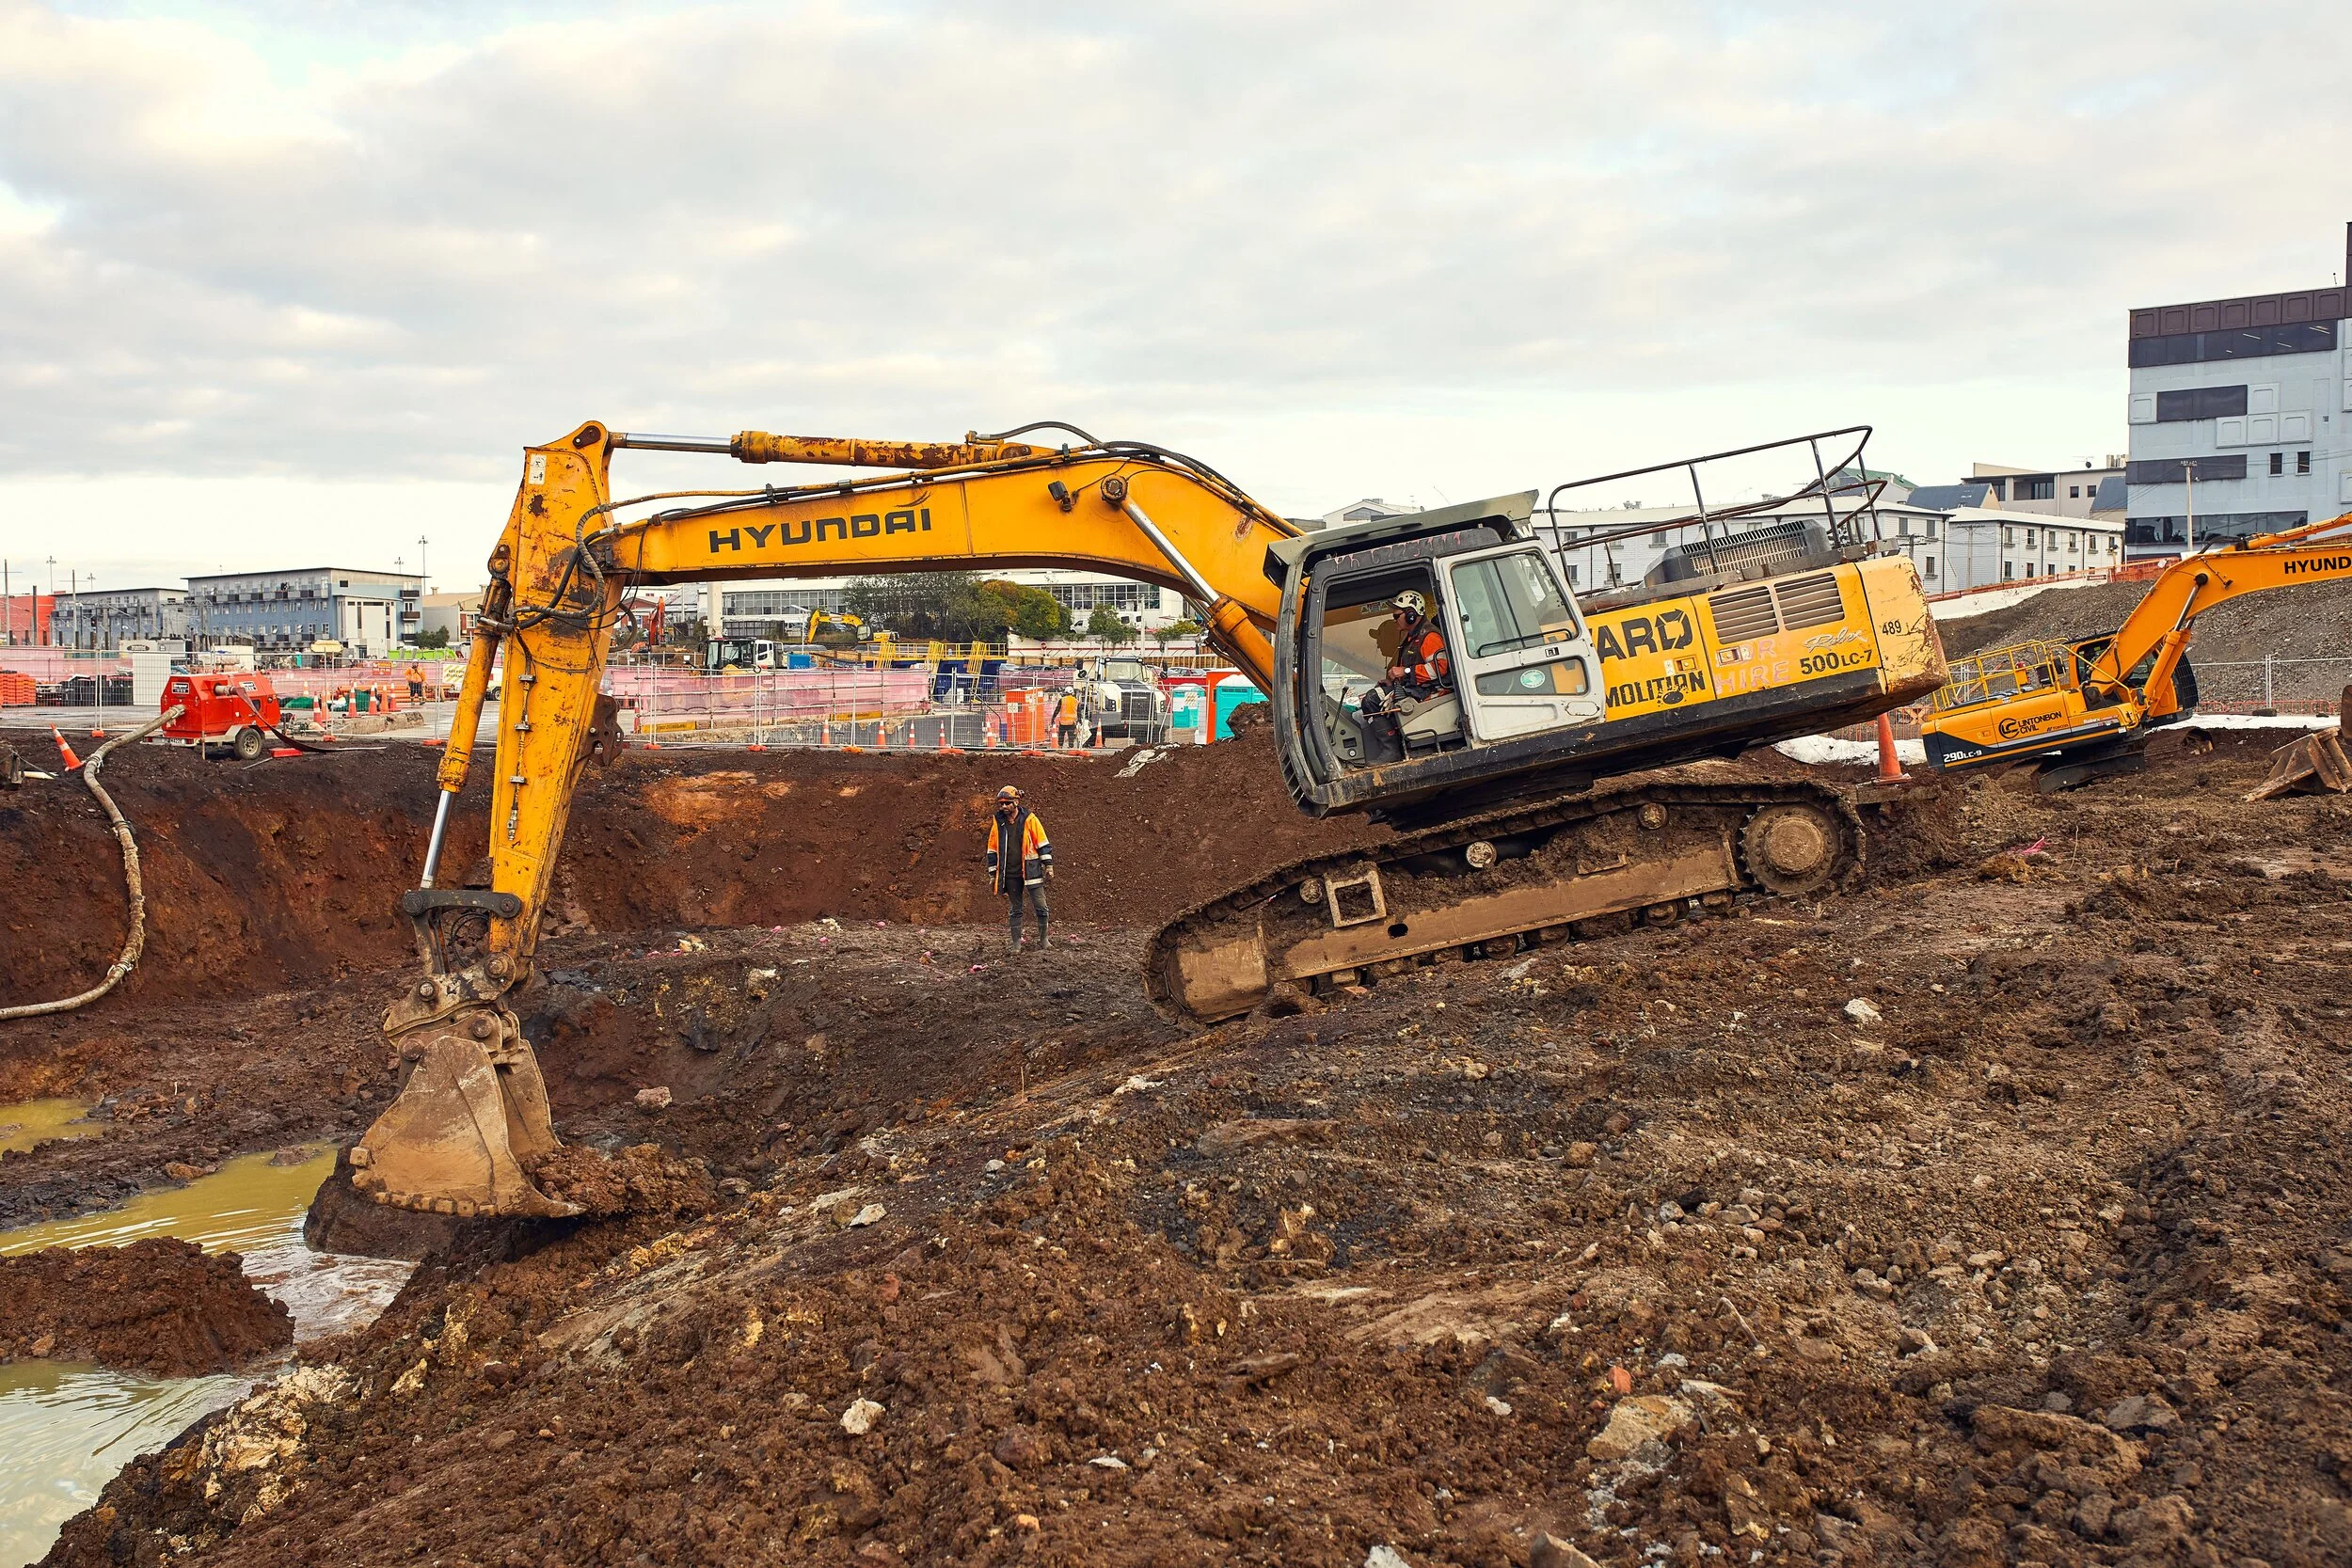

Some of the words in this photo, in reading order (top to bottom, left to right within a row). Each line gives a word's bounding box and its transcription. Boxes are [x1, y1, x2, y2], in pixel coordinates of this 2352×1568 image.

[709, 508, 931, 553] HYUNDAI
[1589, 609, 1693, 664] ARD
[1882, 620, 1902, 636] 489
[1715, 660, 1791, 695] HIRE
[2020, 724, 2040, 734] CIVIL
